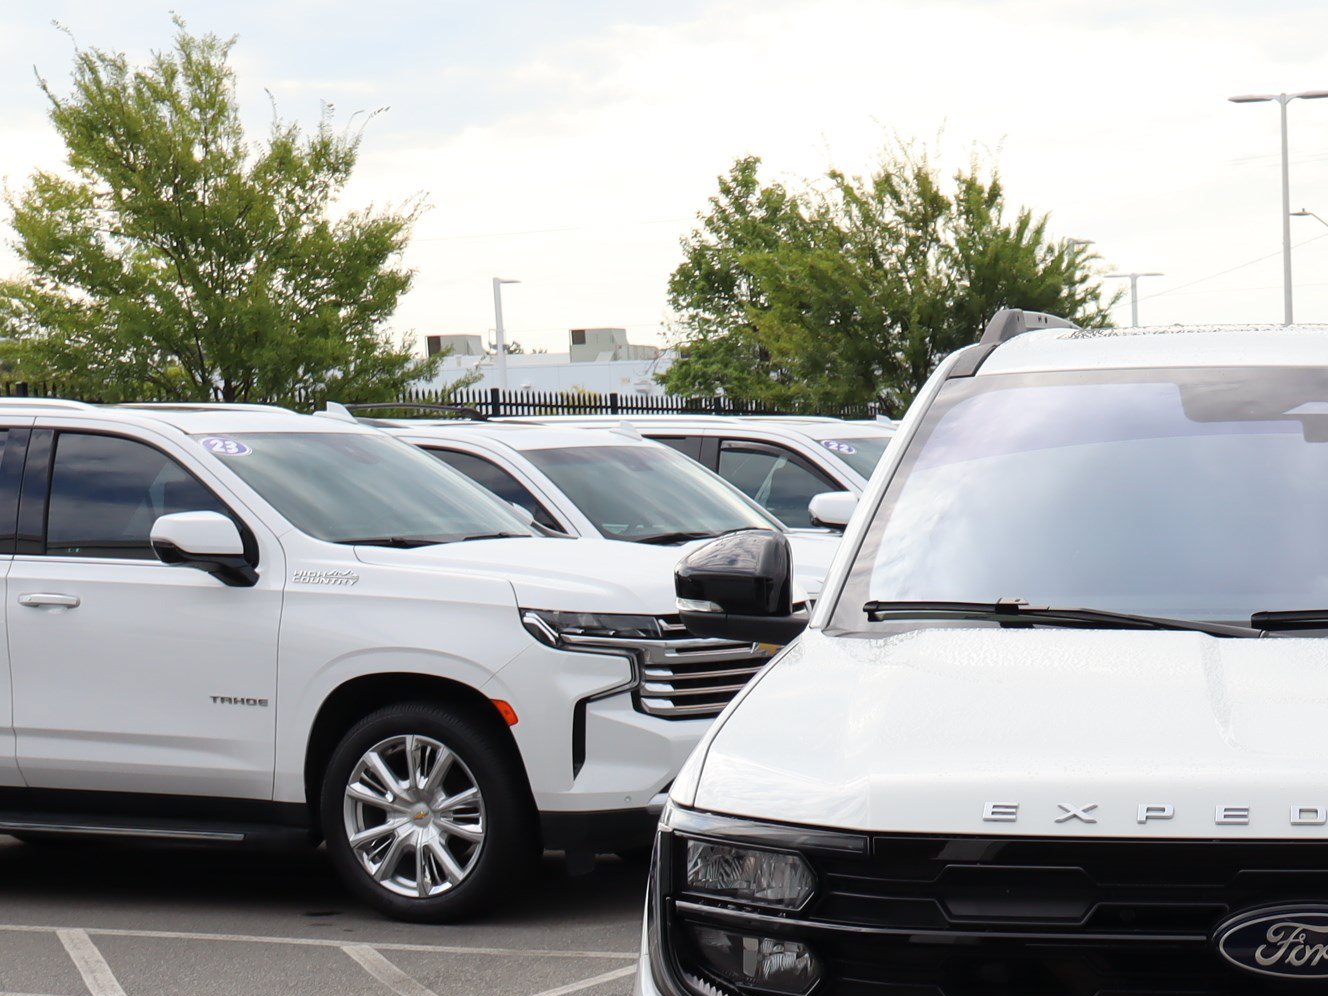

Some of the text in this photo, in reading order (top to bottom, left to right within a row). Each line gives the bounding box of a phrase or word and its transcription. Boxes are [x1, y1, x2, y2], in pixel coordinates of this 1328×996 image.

[209, 439, 239, 453] 23
[828, 440, 850, 452] 22
[293, 569, 328, 578] HIGH
[292, 576, 359, 587] COUNTRY
[209, 695, 269, 707] TAHOE
